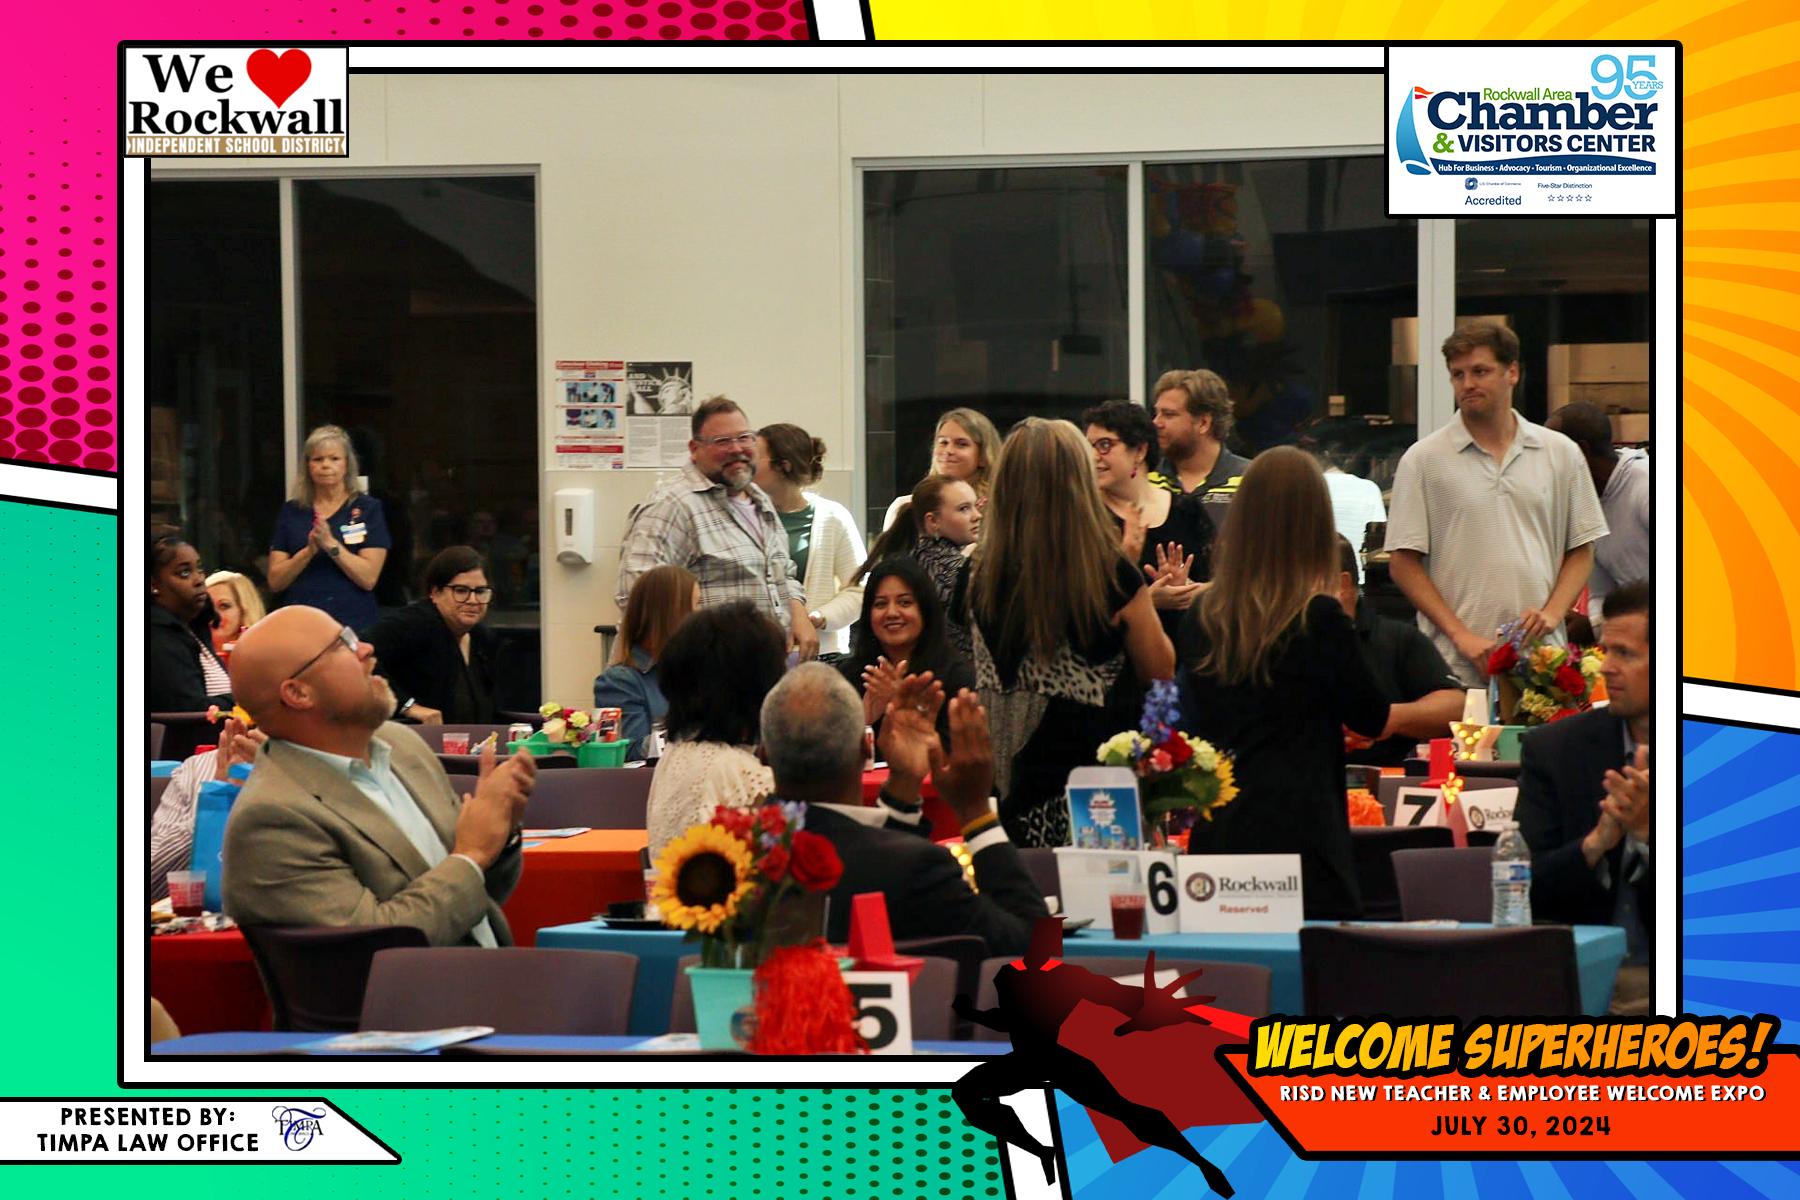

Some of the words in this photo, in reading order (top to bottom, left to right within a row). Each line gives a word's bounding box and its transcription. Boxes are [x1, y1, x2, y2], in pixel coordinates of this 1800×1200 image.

[1403, 794, 1438, 826] 7
[1147, 861, 1178, 916] 6
[1219, 876, 1299, 892] Rockwall
[1219, 904, 1269, 913] Reserved
[848, 983, 898, 1050] 5
